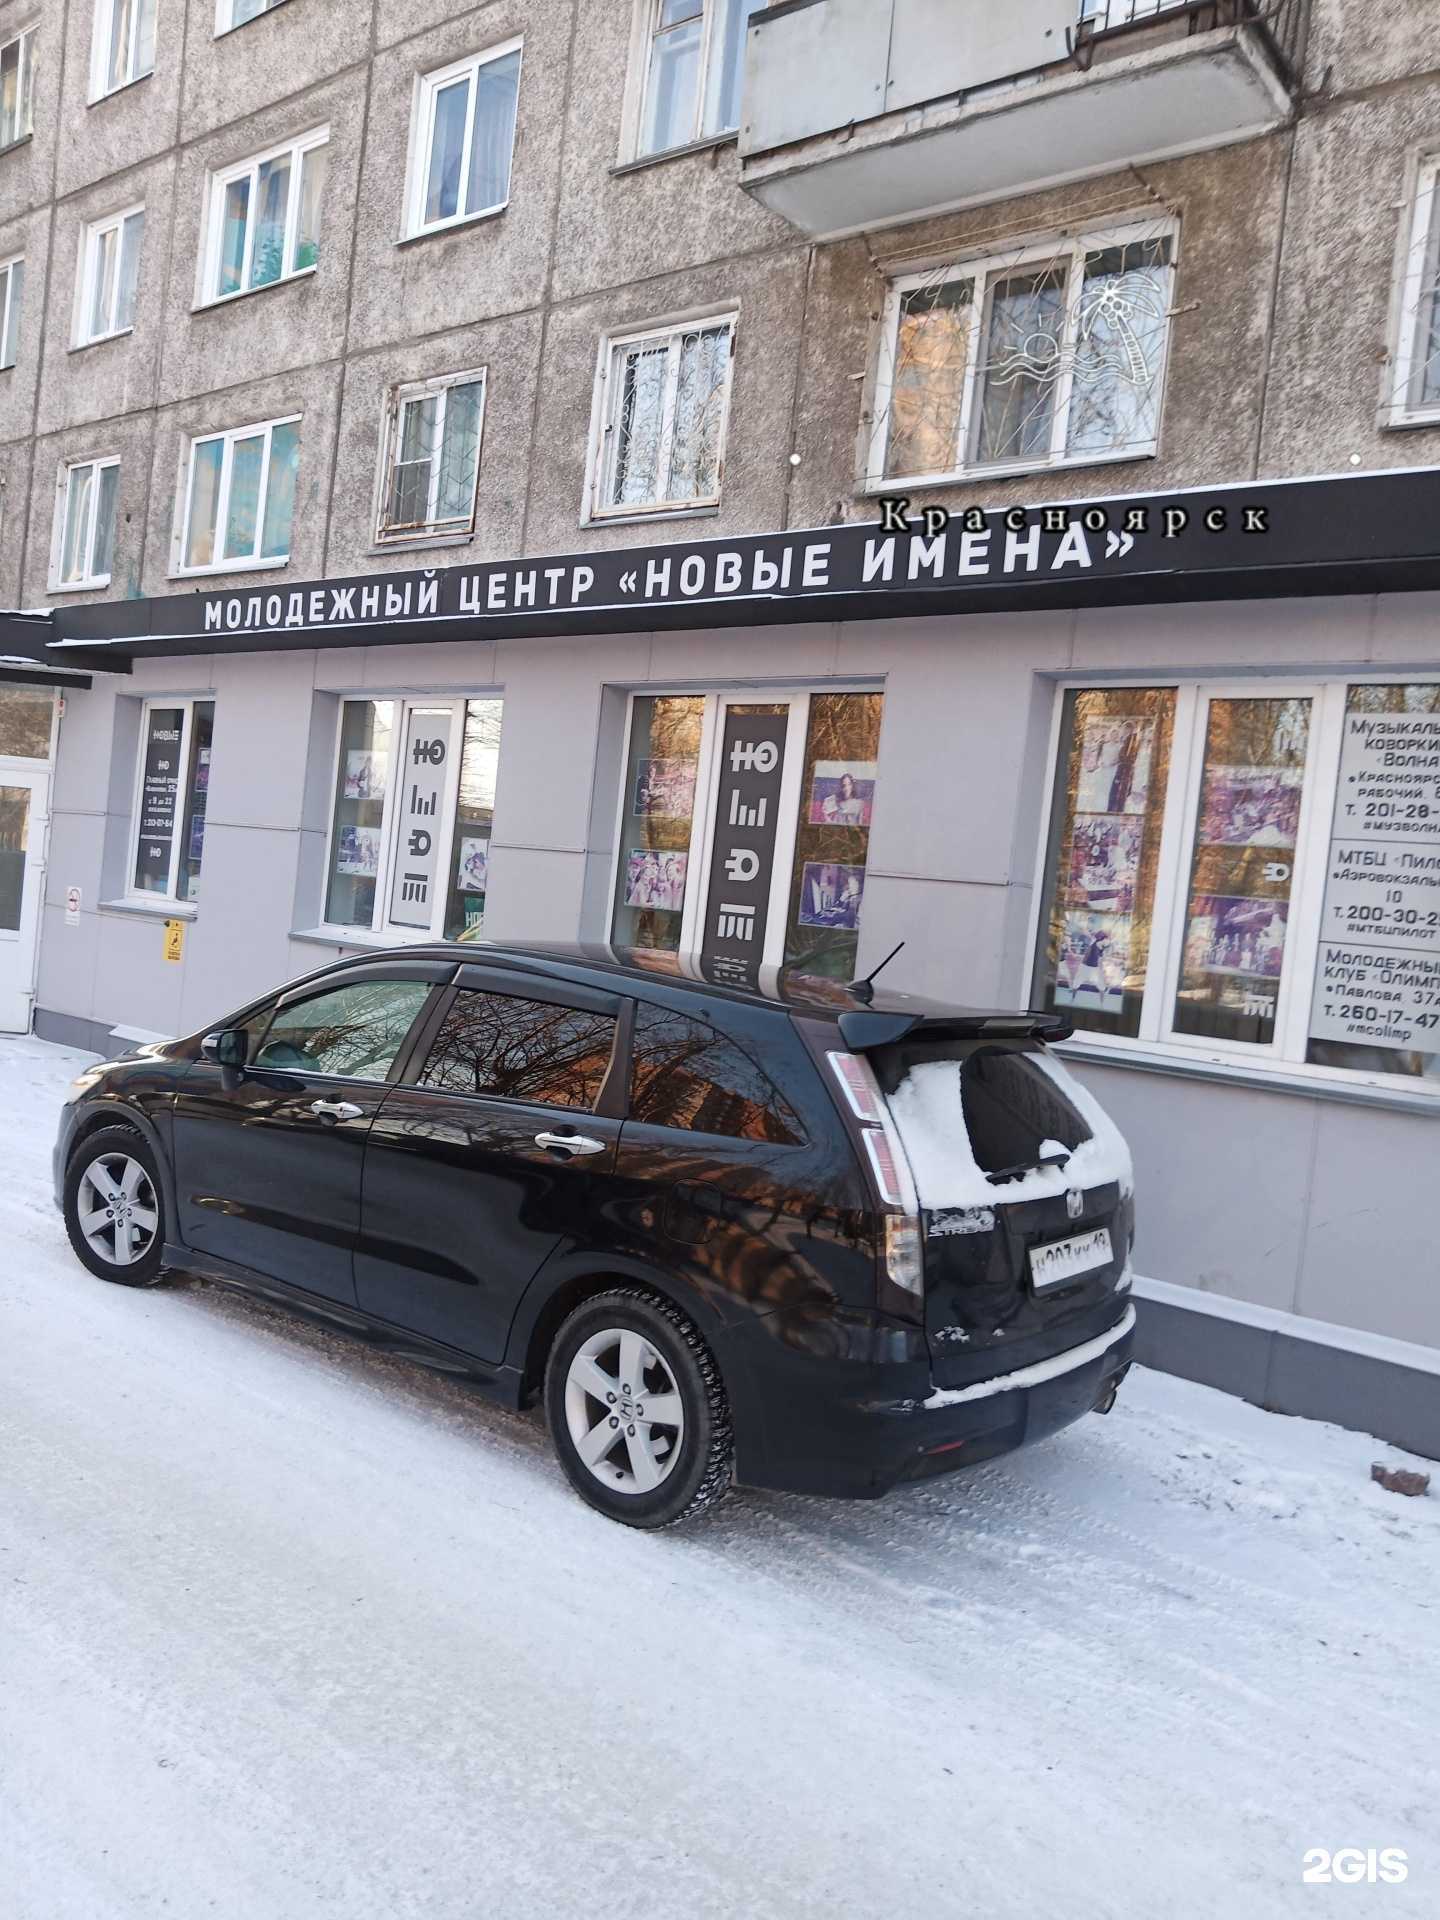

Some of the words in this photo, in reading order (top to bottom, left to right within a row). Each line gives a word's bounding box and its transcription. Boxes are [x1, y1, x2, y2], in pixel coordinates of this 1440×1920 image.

[204, 570, 440, 630] МОЛОДЕЖНЫЙ
[459, 566, 595, 614] ЦЕНТР
[618, 543, 833, 598] «НОВЫЕ
[861, 521, 1134, 583] ИМЕНА»
